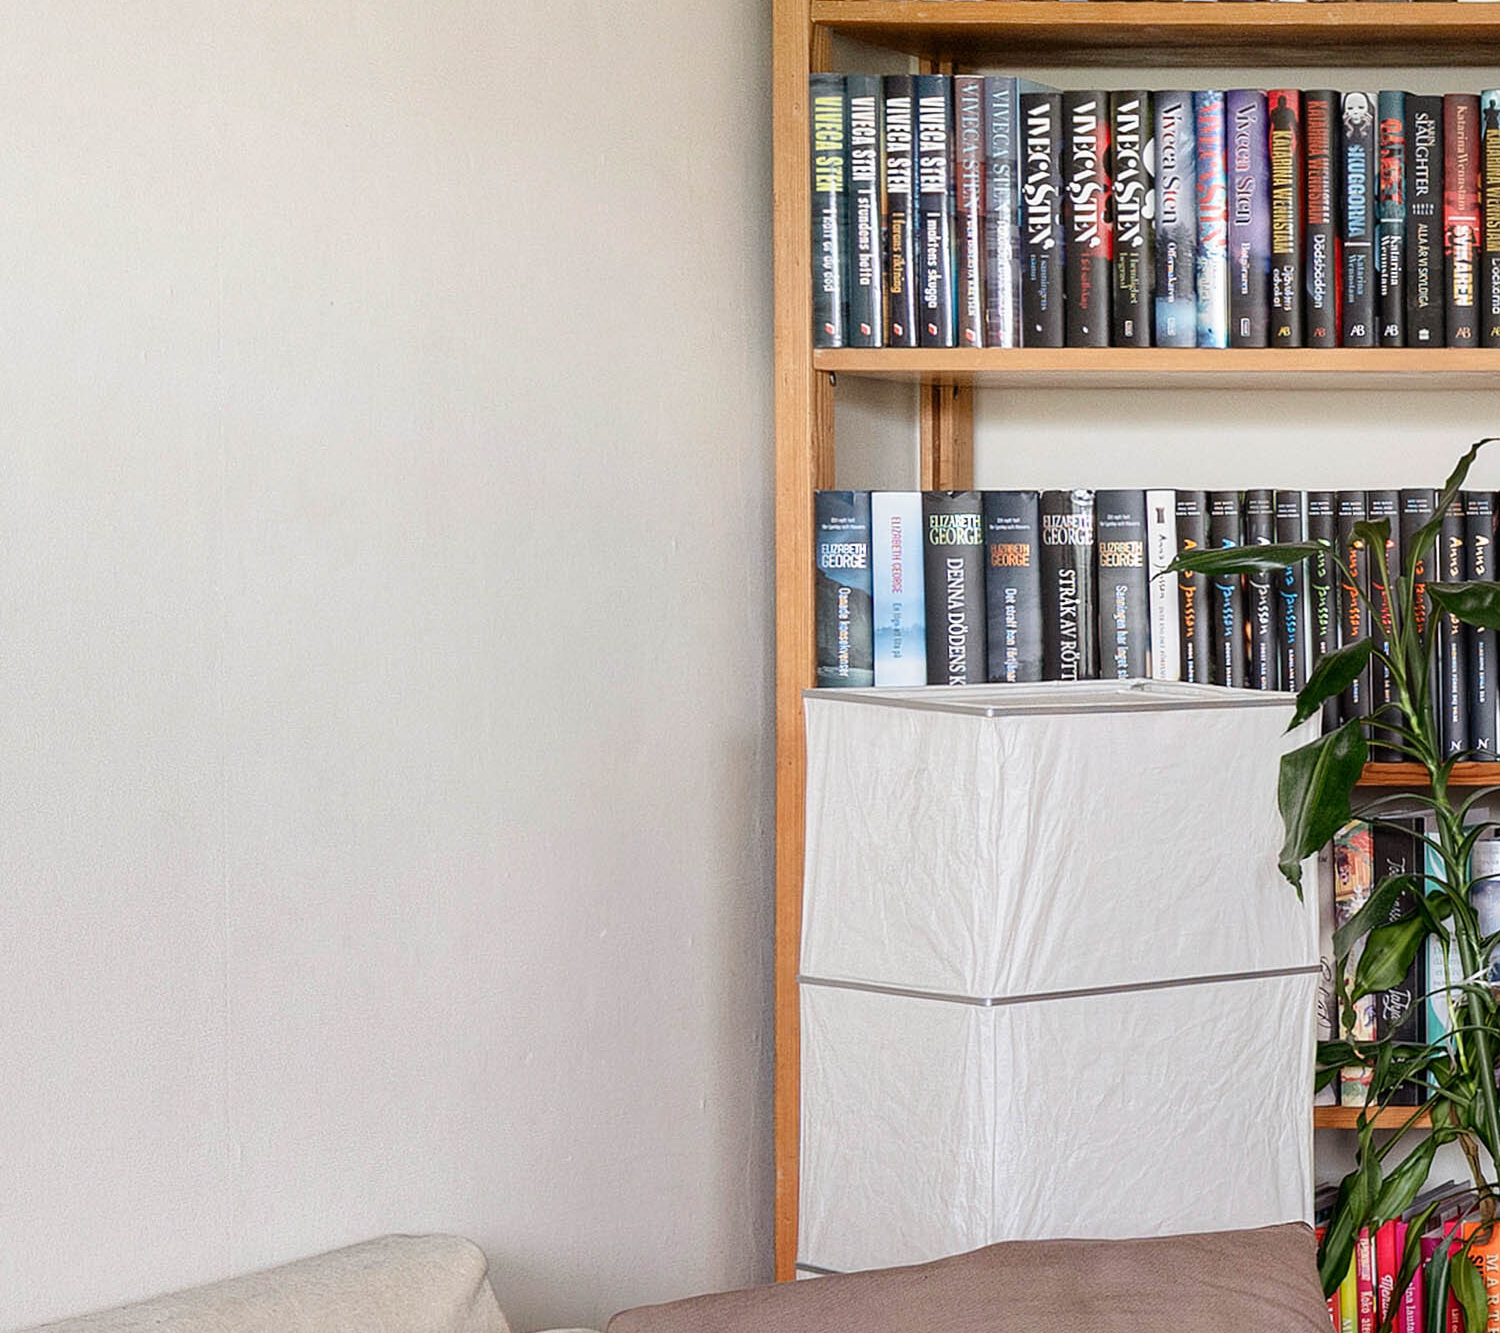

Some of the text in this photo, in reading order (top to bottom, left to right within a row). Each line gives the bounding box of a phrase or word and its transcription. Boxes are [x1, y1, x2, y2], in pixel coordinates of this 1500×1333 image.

[1347, 146, 1367, 237] SKUGGORNA
[929, 529, 982, 545] GEORGE
[947, 558, 964, 674] DENNA DÖDENS
